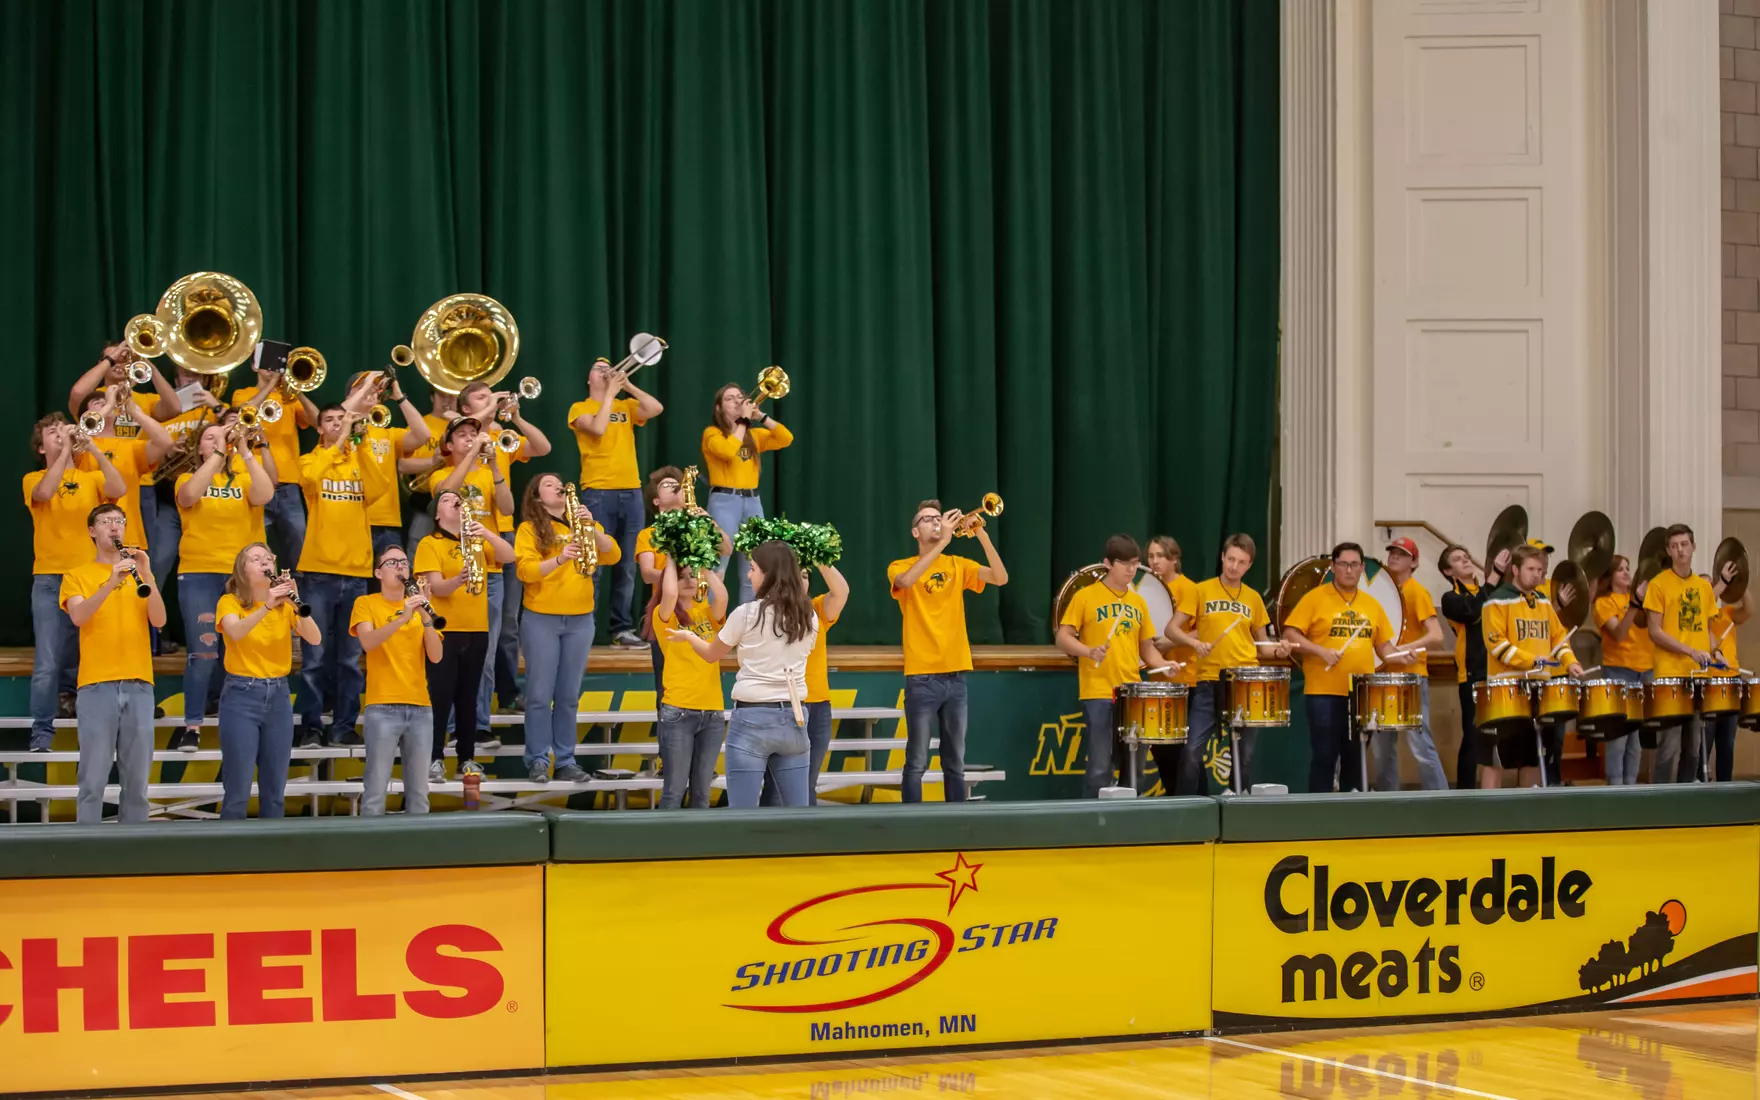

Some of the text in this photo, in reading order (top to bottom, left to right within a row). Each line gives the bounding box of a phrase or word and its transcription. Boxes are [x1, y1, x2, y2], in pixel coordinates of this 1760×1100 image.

[1096, 603, 1143, 624] NDSU
[1205, 600, 1252, 618] NDSU
[1328, 626, 1373, 639] SEVEN
[1264, 854, 1593, 934] Cloverdale
[730, 917, 1059, 992] SHOOTING STAR
[1281, 937, 1462, 1003] meats
[0, 923, 505, 1034] HEELS
[811, 1014, 977, 1041] Mahnomen, MN
